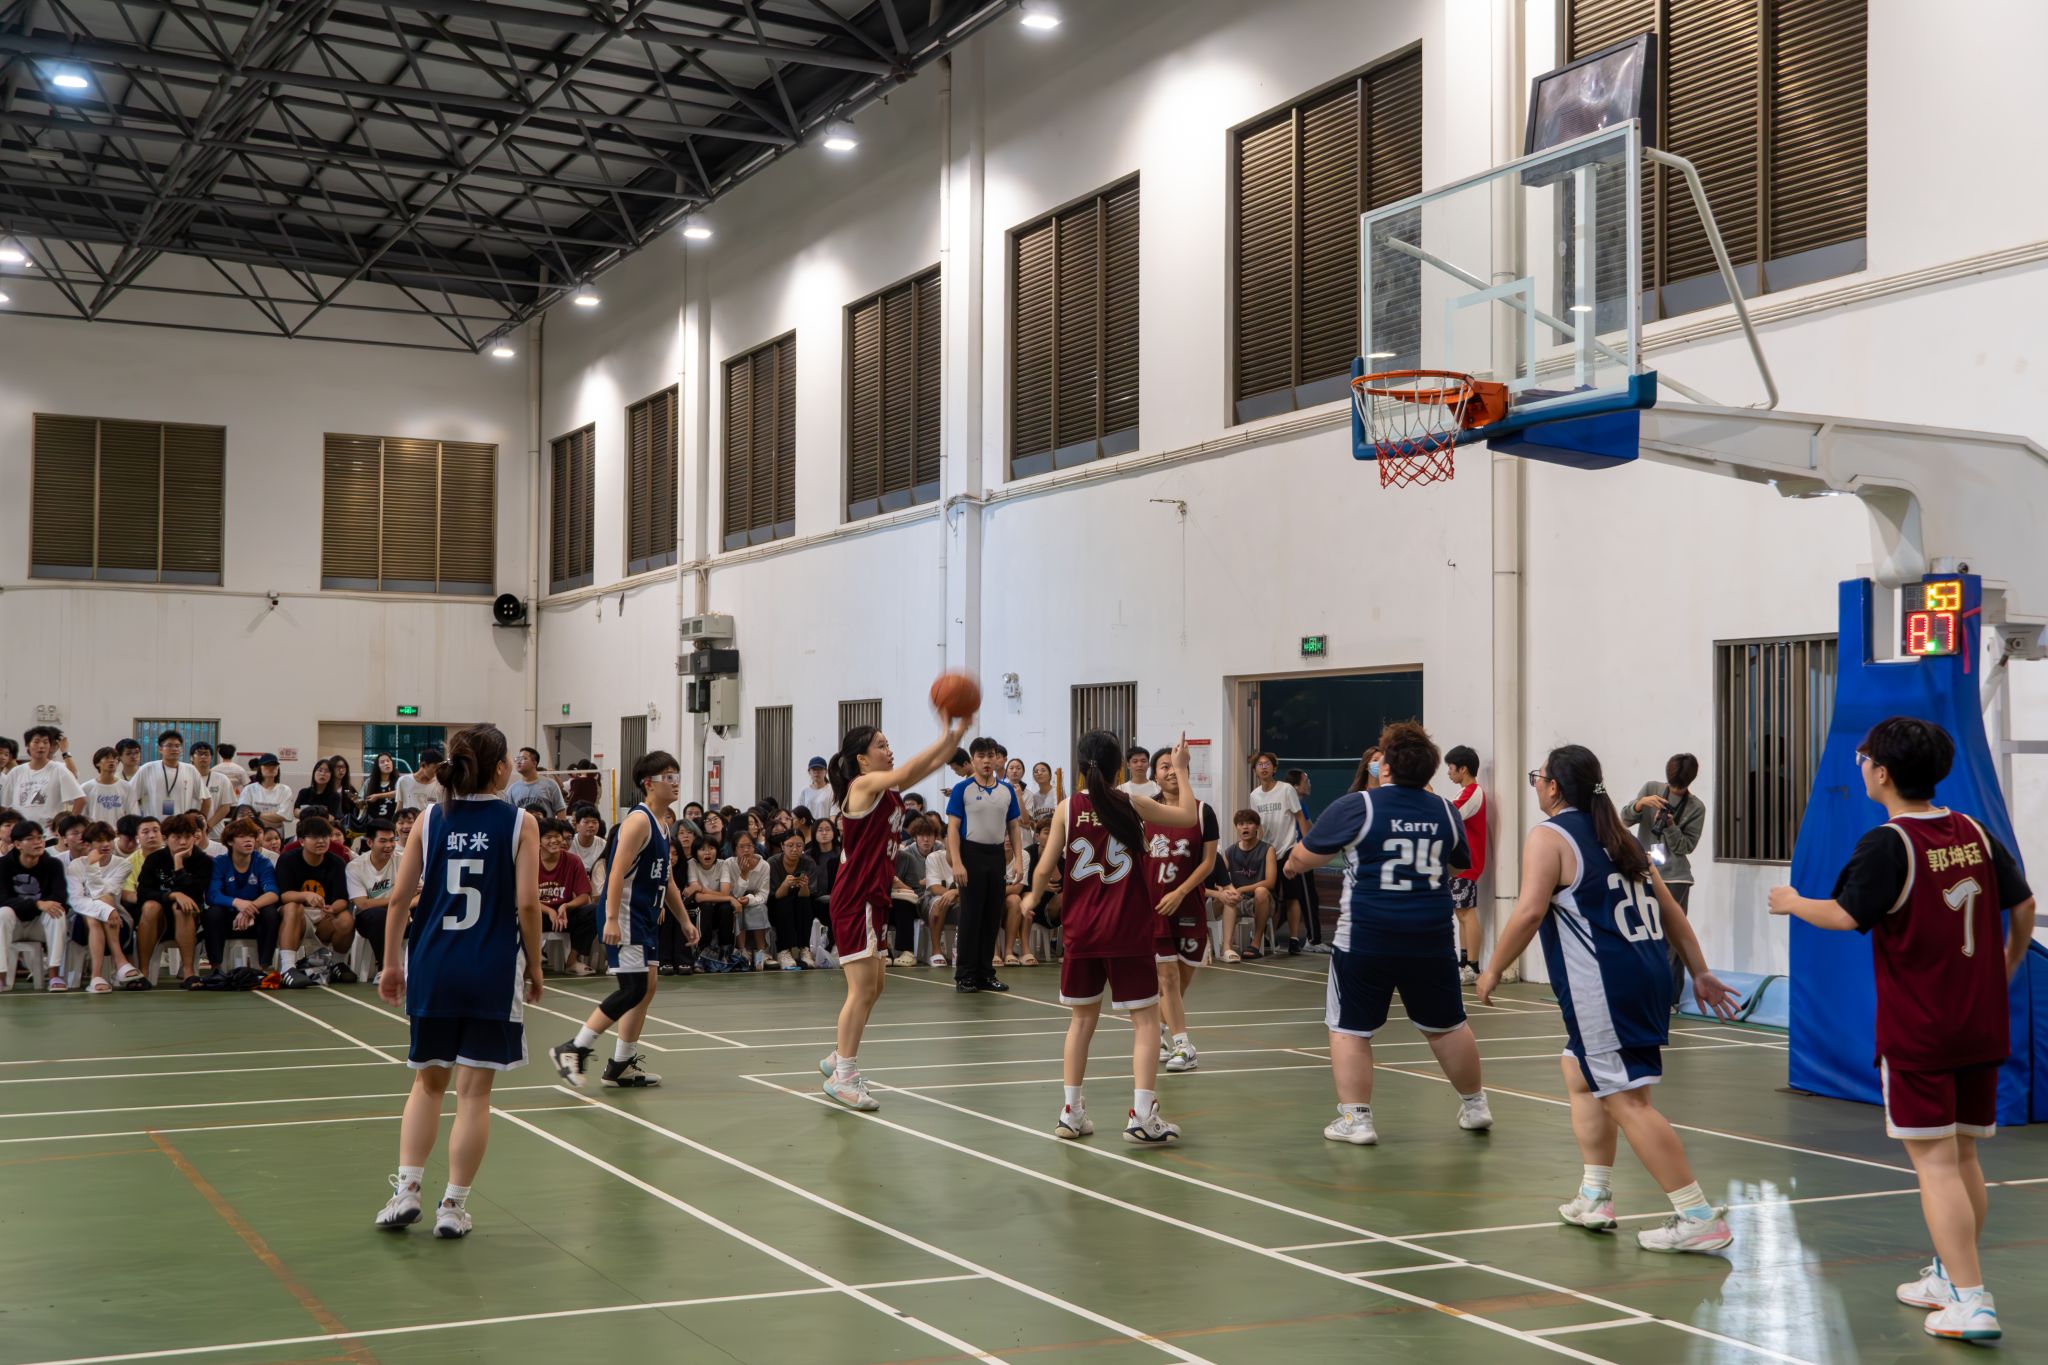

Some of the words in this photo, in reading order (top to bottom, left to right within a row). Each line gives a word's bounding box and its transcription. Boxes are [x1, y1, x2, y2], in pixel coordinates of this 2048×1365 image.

[379, 804, 388, 815] 3
[1391, 819, 1439, 835] Karry
[447, 832, 489, 852] 虾米
[1149, 833, 1191, 858] 信工
[1069, 835, 1133, 884] 25
[1380, 838, 1443, 891] 24
[372, 879, 391, 892] NIKE
[1158, 862, 1179, 884] 15
[442, 858, 484, 931] 5
[1607, 872, 1664, 942] 26
[1942, 876, 1982, 957] 7
